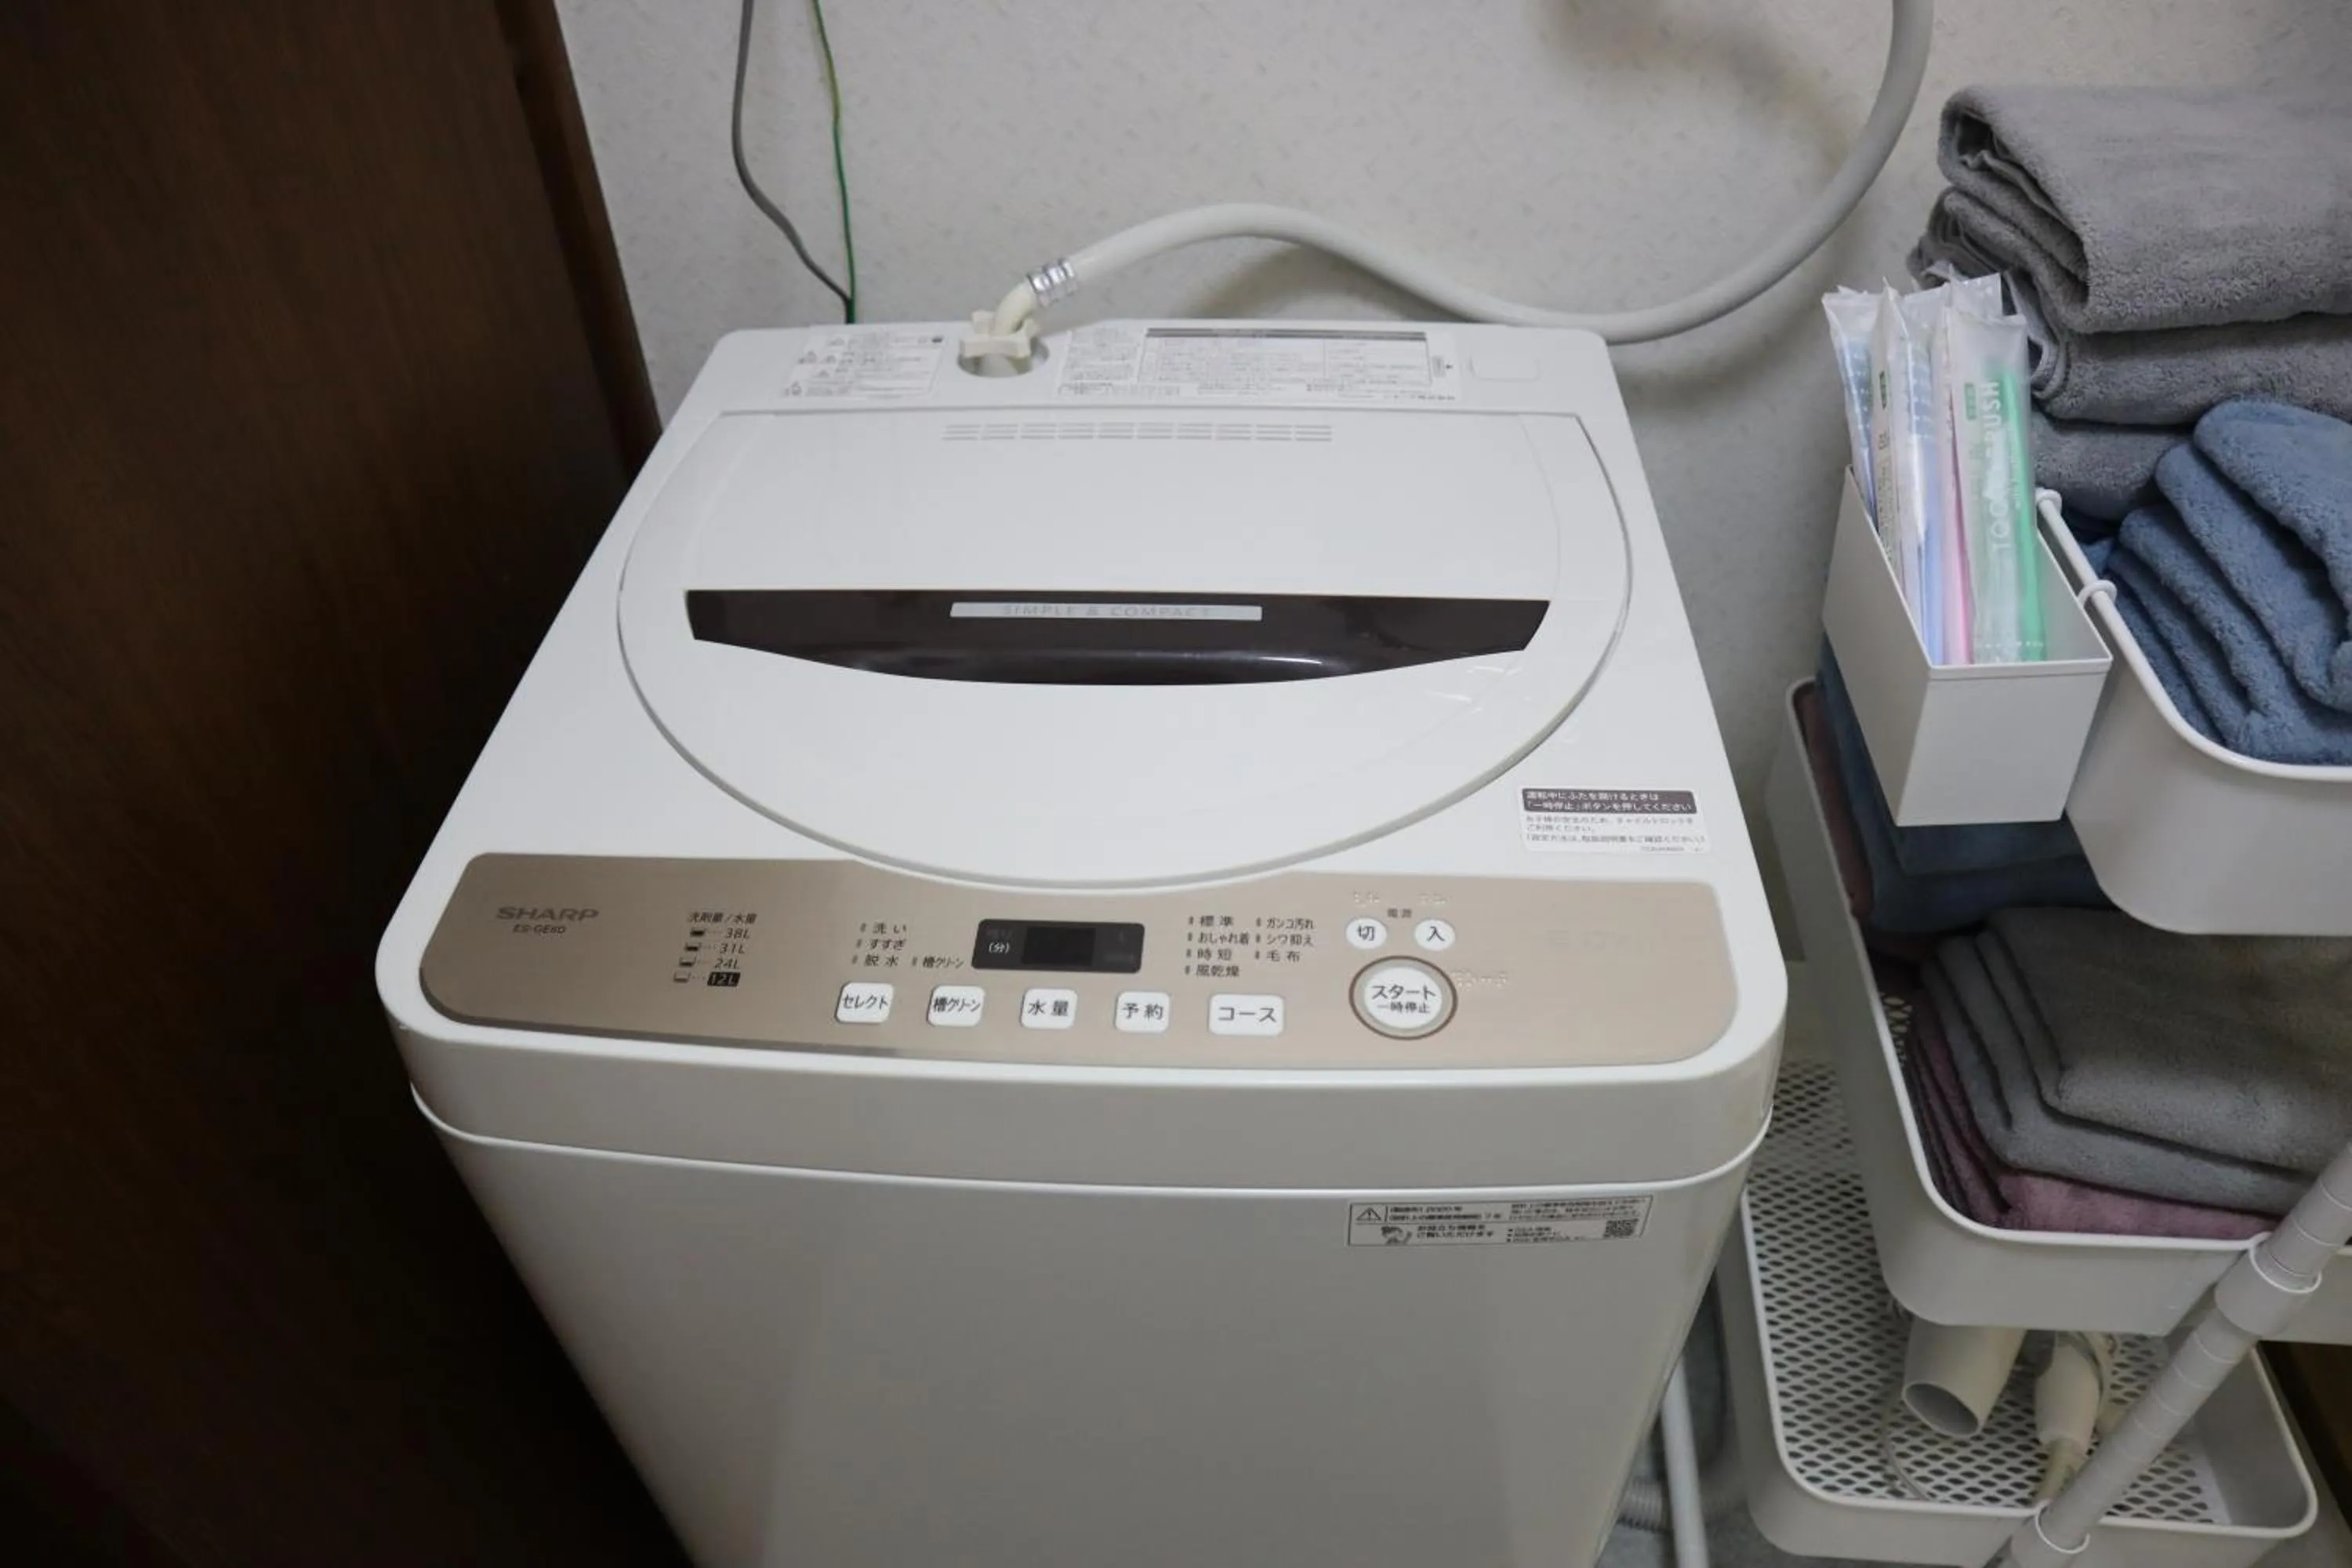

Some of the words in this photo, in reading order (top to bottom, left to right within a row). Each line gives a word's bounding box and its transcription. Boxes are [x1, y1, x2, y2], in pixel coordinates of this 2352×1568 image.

[495, 906, 599, 921] SHARP
[1200, 915, 1234, 927] 標準
[1266, 917, 1314, 930] ガンコ汚れ
[725, 927, 750, 939] 38L
[873, 923, 906, 935] 洗い
[1358, 926, 1375, 941] 切
[1427, 927, 1446, 942] 入
[870, 939, 906, 950] すすぎ
[1198, 932, 1249, 945] おしゃれ着
[1266, 933, 1314, 946] シワ抑え
[719, 943, 745, 954] 31L
[1197, 948, 1232, 960] 時短
[864, 954, 899, 967] 脱水
[923, 956, 964, 968] 槽クリーン
[1266, 949, 1300, 962] 毛布
[714, 957, 740, 969] 24L
[1196, 964, 1240, 977] 風乾燥
[710, 973, 737, 985] 12L
[1371, 985, 1436, 1000] スタート
[843, 994, 888, 1009] セレクト
[933, 997, 981, 1012] 槽クリーン
[1028, 1001, 1069, 1017] 水量
[1121, 1004, 1164, 1020] 予約
[1218, 1006, 1277, 1023] コース
[1377, 1003, 1431, 1014] 一時停止
